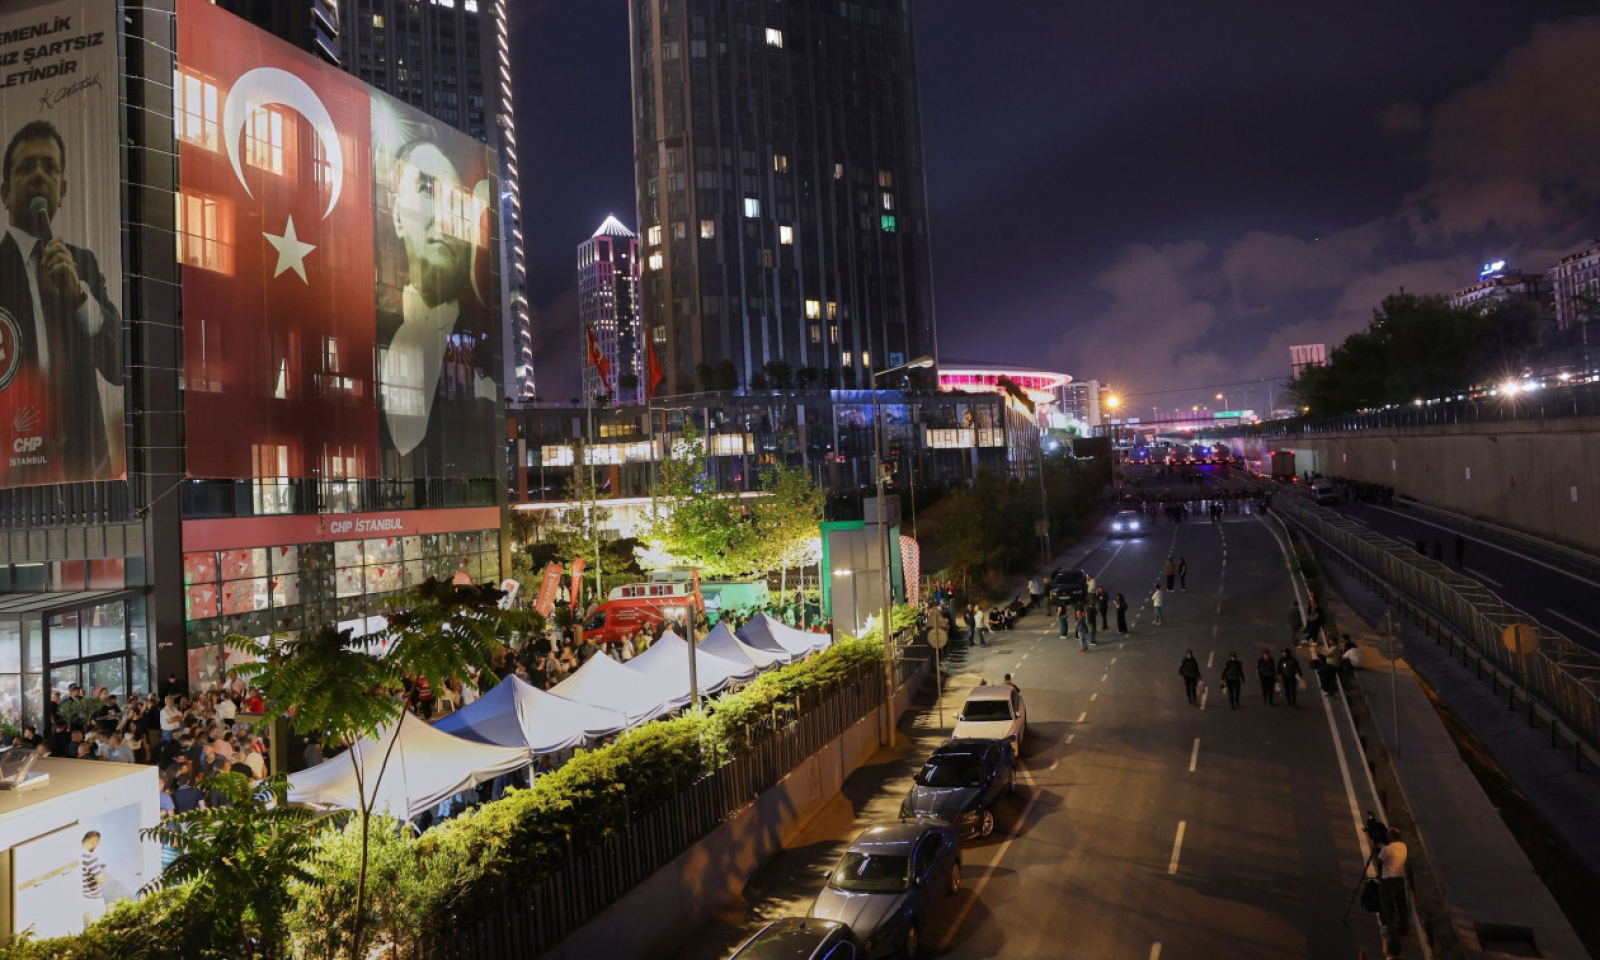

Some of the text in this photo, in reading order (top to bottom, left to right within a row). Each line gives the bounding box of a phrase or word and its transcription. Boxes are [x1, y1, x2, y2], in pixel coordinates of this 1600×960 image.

[23, 31, 104, 65] ŞARTSIZ
[13, 436, 43, 452] CHP
[330, 517, 403, 533] CHP İSTANBUL
